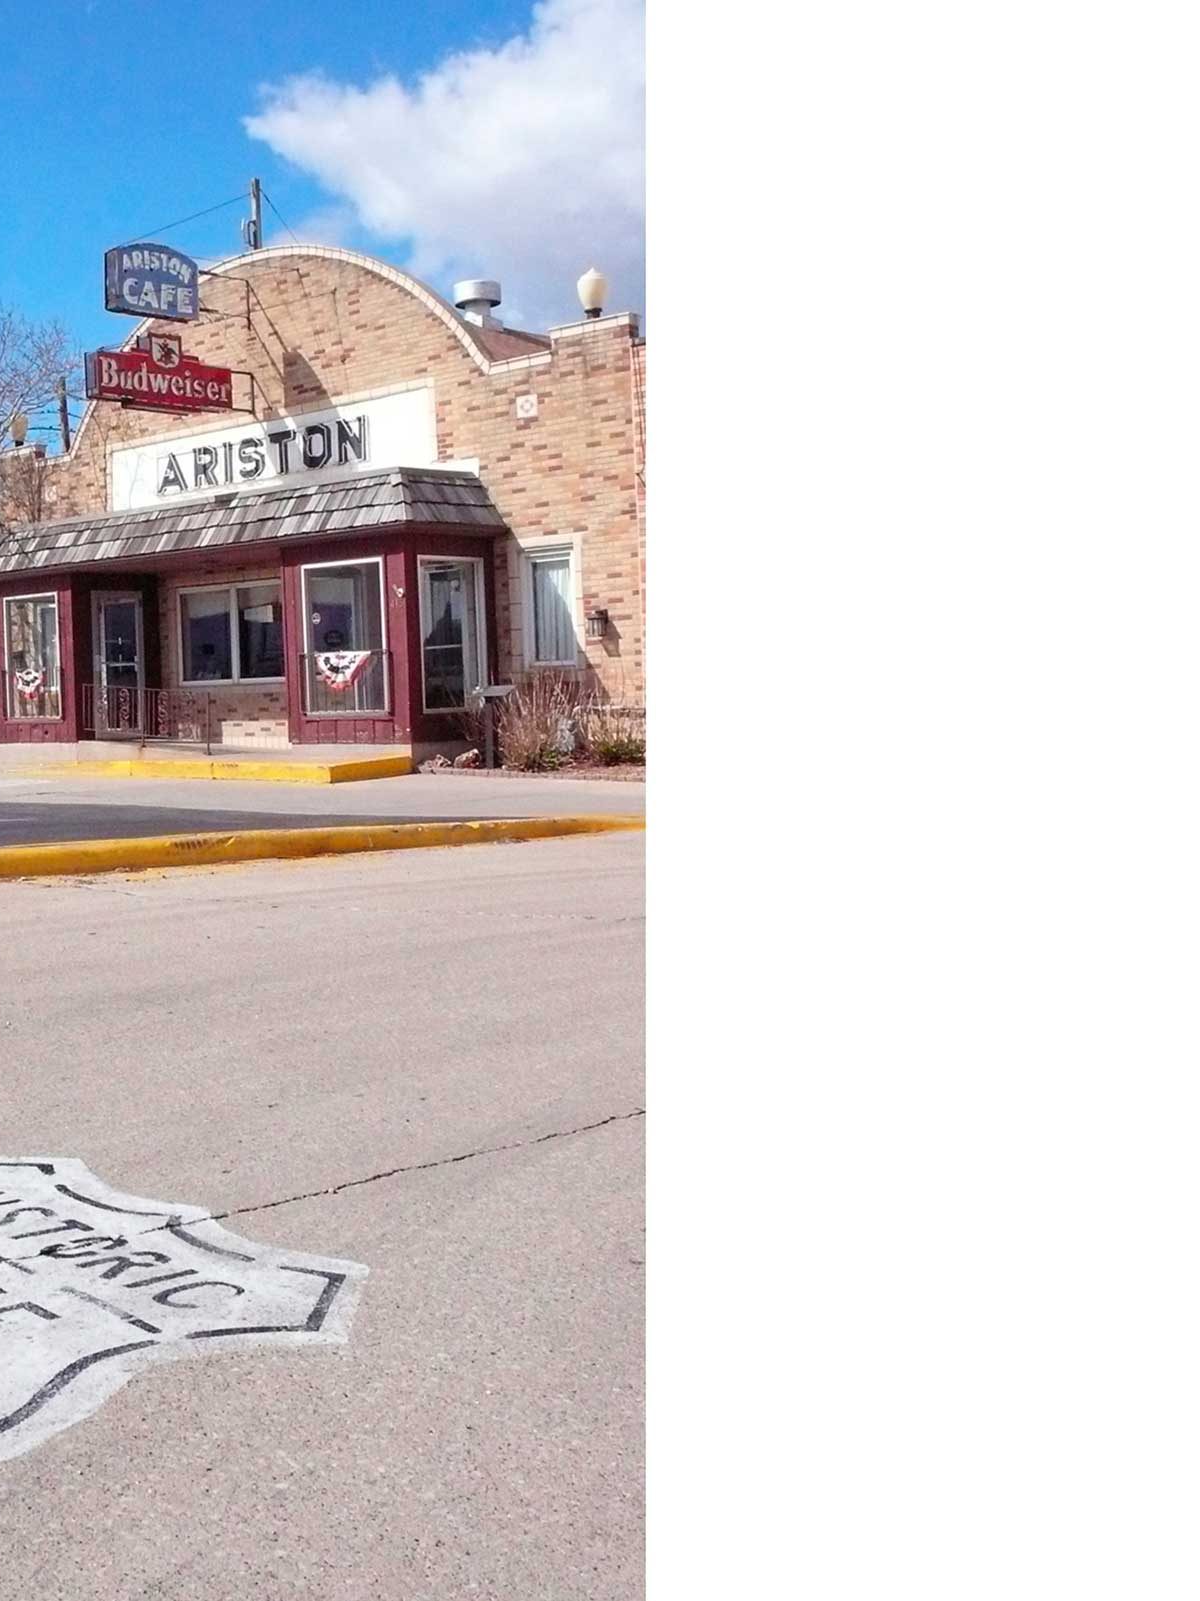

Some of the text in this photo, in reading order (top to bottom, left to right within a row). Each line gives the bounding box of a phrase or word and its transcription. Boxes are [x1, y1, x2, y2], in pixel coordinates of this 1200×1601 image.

[122, 250, 193, 284] ARISTON
[123, 277, 193, 314] CAFE
[99, 356, 231, 402] Budweiser
[157, 415, 368, 494] ARISTON
